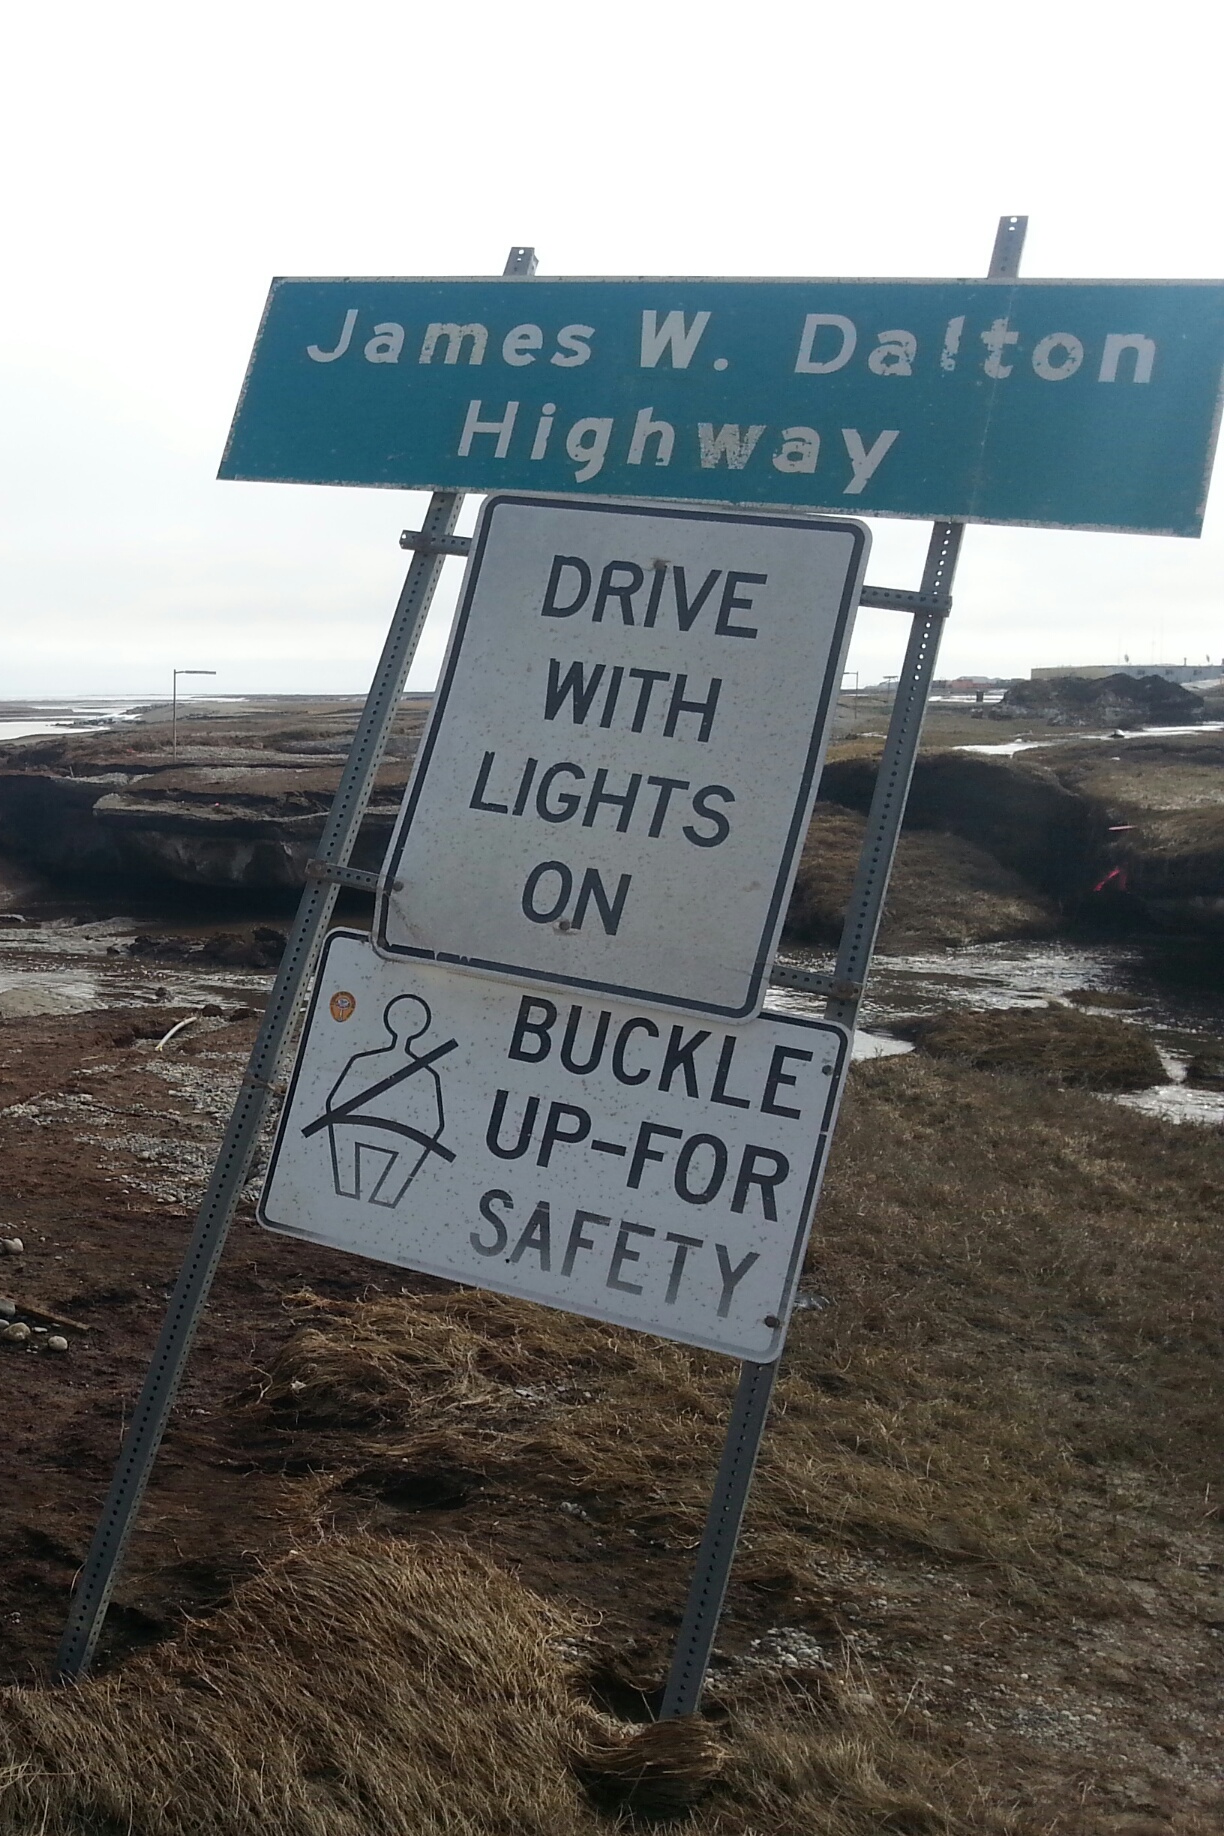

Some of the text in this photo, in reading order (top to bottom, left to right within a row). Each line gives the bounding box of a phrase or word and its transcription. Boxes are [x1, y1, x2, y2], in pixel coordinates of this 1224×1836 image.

[306, 307, 1158, 384] James W. Dalton
[457, 399, 900, 494] Highway
[541, 554, 767, 639] DRIVE
[544, 657, 722, 742] WITH
[469, 751, 735, 848] LIGHTS
[521, 860, 632, 936] ON
[508, 995, 814, 1120] BUCKLE
[485, 1089, 790, 1222] UP-FOR
[469, 1188, 760, 1318] SAFETY
